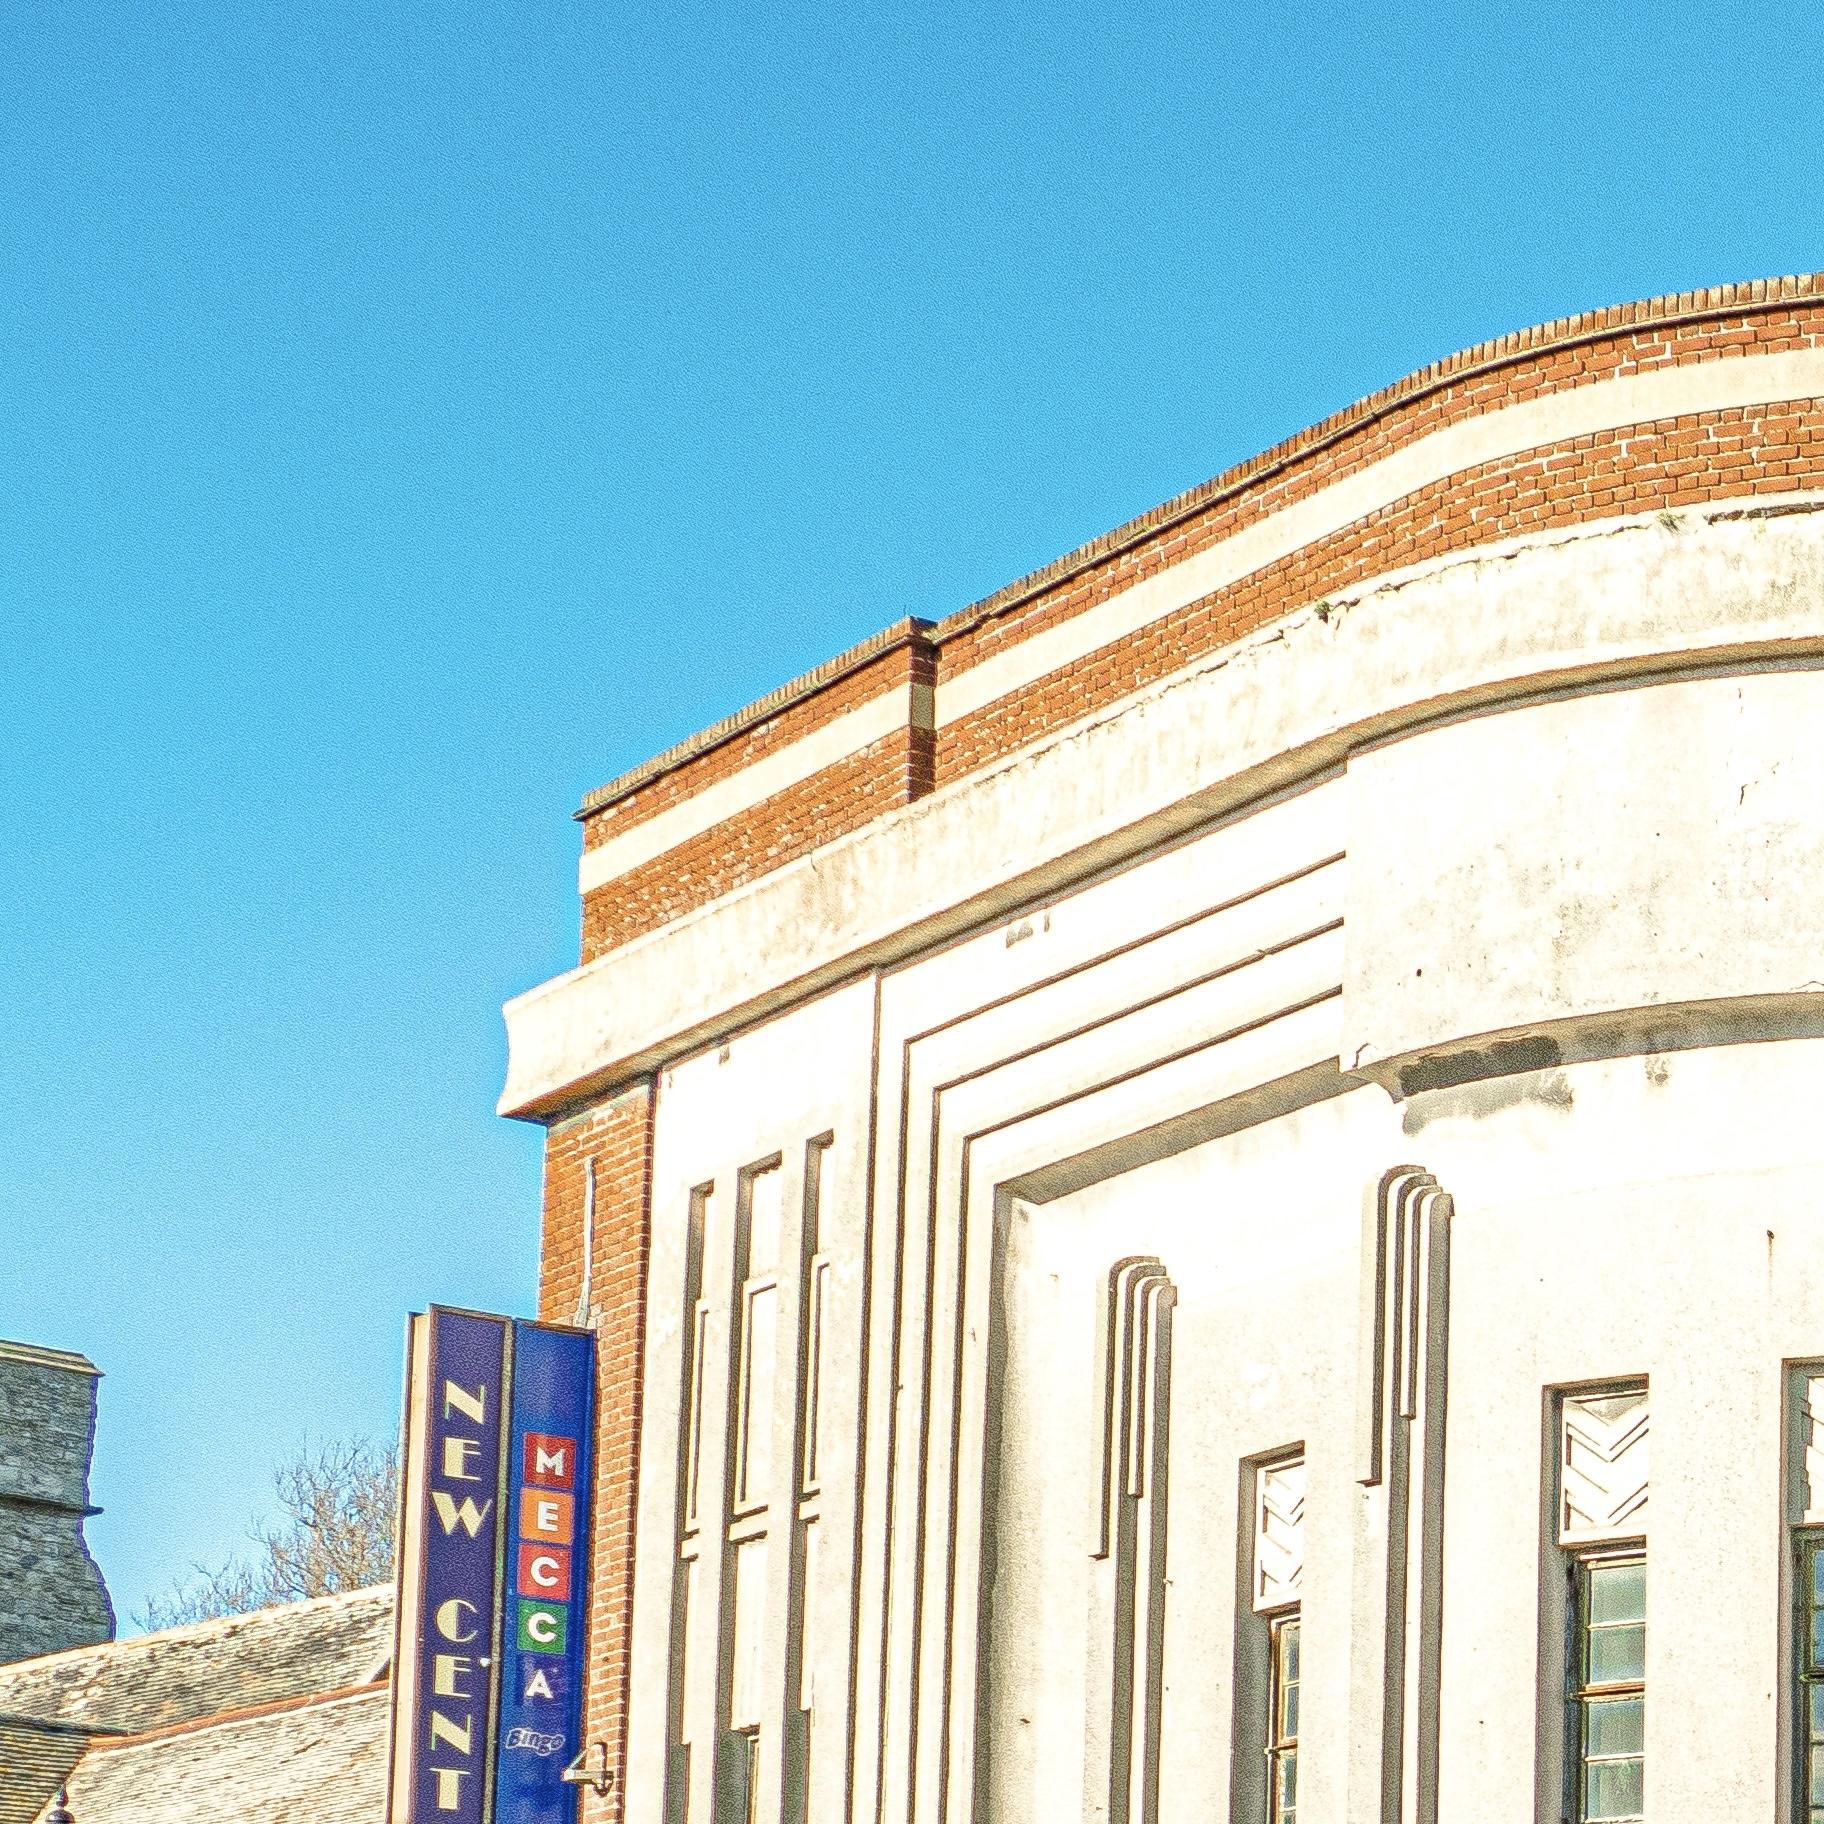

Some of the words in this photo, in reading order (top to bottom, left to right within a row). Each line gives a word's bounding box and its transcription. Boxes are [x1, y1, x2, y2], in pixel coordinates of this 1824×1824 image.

[431, 1380, 493, 1538] NEW
[524, 1446, 565, 1700] MECCA
[505, 1727, 565, 1757] Bingo
